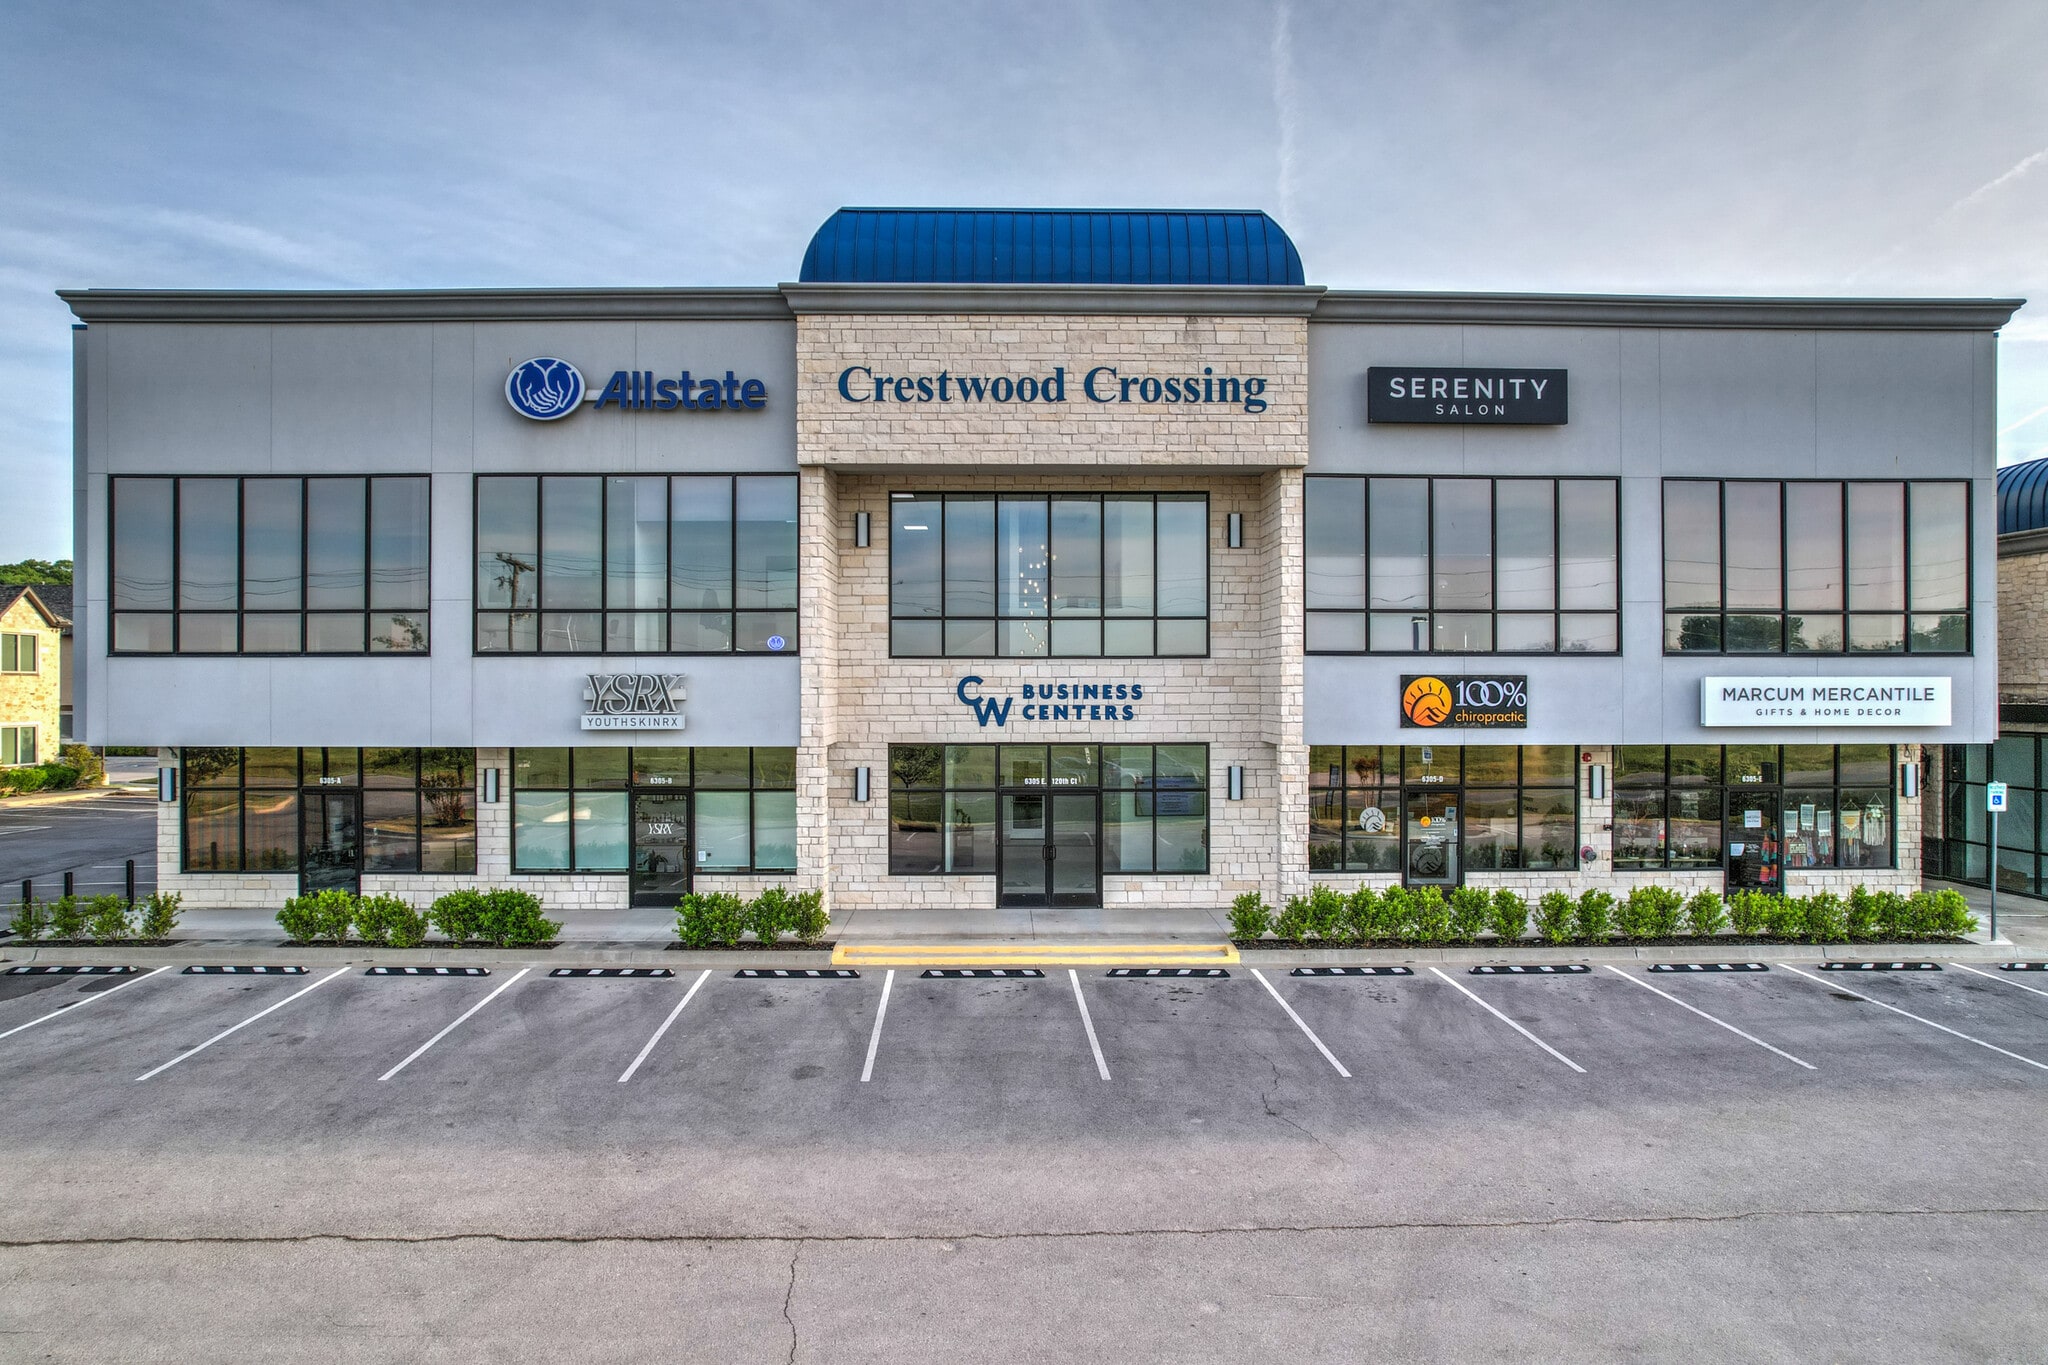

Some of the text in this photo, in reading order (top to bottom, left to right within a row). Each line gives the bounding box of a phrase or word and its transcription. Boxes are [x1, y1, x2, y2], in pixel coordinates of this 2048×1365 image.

[593, 370, 767, 410] Allstate
[837, 365, 1268, 413] Crestwood Crossing
[1389, 377, 1549, 400] SERENITY
[1435, 404, 1505, 416] SALON
[585, 673, 686, 715] YSRX
[1022, 684, 1143, 700] BUSINESS
[1455, 680, 1527, 707] 100%
[1722, 687, 1935, 702] MARCUM MERCANTILE
[1022, 704, 1135, 721] CENTERS
[1755, 708, 1902, 716] GIFTS & HOME DECOR
[587, 717, 679, 727] YOUTHSKINRX
[1741, 775, 1763, 783] 6305-E
[648, 823, 674, 834] YSRX
